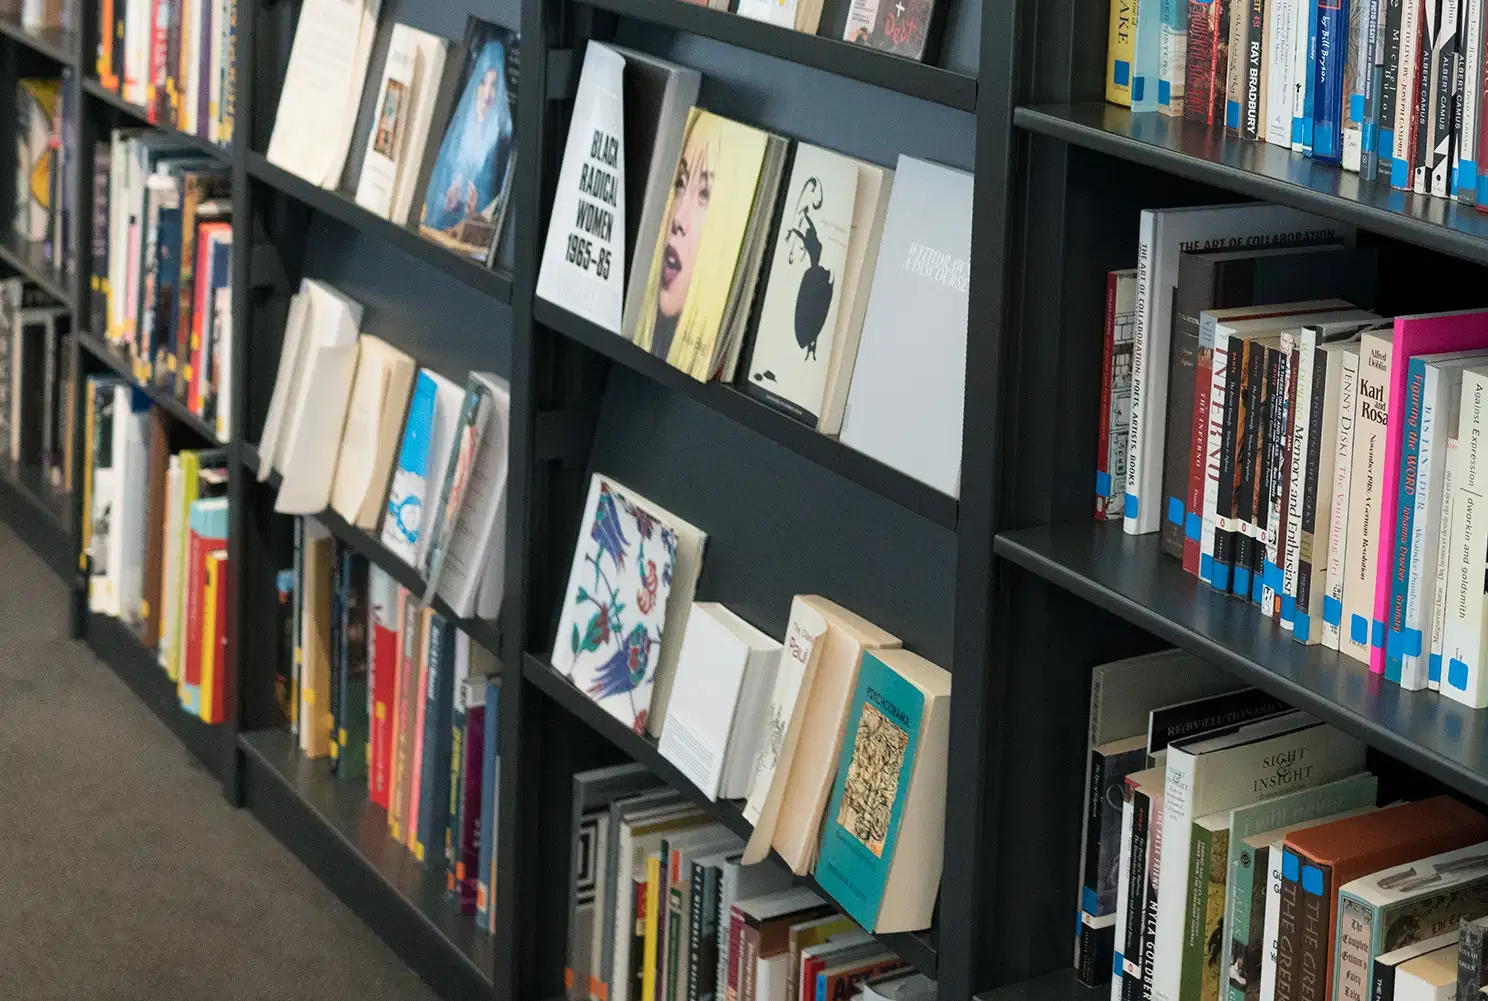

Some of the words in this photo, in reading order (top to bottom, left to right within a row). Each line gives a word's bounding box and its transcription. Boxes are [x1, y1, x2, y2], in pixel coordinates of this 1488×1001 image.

[1252, 15, 1260, 28] 451
[1250, 41, 1260, 64] RAY
[1387, 28, 1400, 91] Michel
[1421, 50, 1430, 84] ALBERT
[1441, 56, 1450, 89] ALBERT
[1456, 54, 1465, 86] ALBERT
[1246, 68, 1260, 134] BRADBURY
[1420, 88, 1428, 124] CAMUS
[1438, 92, 1448, 130] CAMUS
[1454, 92, 1464, 130] CAMUS
[590, 130, 619, 170] BLACK
[578, 162, 618, 208] RADICAL
[576, 198, 614, 242] WOMEN
[1138, 243, 1148, 260] THE
[1137, 262, 1146, 282] ART
[1136, 284, 1146, 297] OF
[1134, 298, 1145, 376] COLLABORATION:
[1368, 360, 1386, 373] Döblin
[1370, 348, 1386, 360] Alfred
[1131, 378, 1140, 409] POETS,
[1360, 378, 1384, 402] Karl
[1472, 383, 1484, 424] Against
[1361, 402, 1388, 426] Rosa
[1129, 413, 1139, 452] ARTISTS,
[1127, 454, 1136, 486] BOOKS
[1468, 428, 1481, 486] Expression
[1464, 498, 1476, 542] dworkin
[1463, 544, 1472, 564] and
[1458, 566, 1471, 618] goldsmith
[1262, 748, 1308, 769] SIGHT
[1252, 766, 1314, 792] INSIGHT
[1147, 900, 1158, 936] MYLA
[1306, 902, 1320, 946] THE
[1351, 918, 1364, 932] The
[1342, 934, 1368, 952] Complete
[1142, 941, 1156, 1000] GOLDBER
[1341, 952, 1368, 968] Grimm's
[1346, 970, 1361, 984] Fairy
